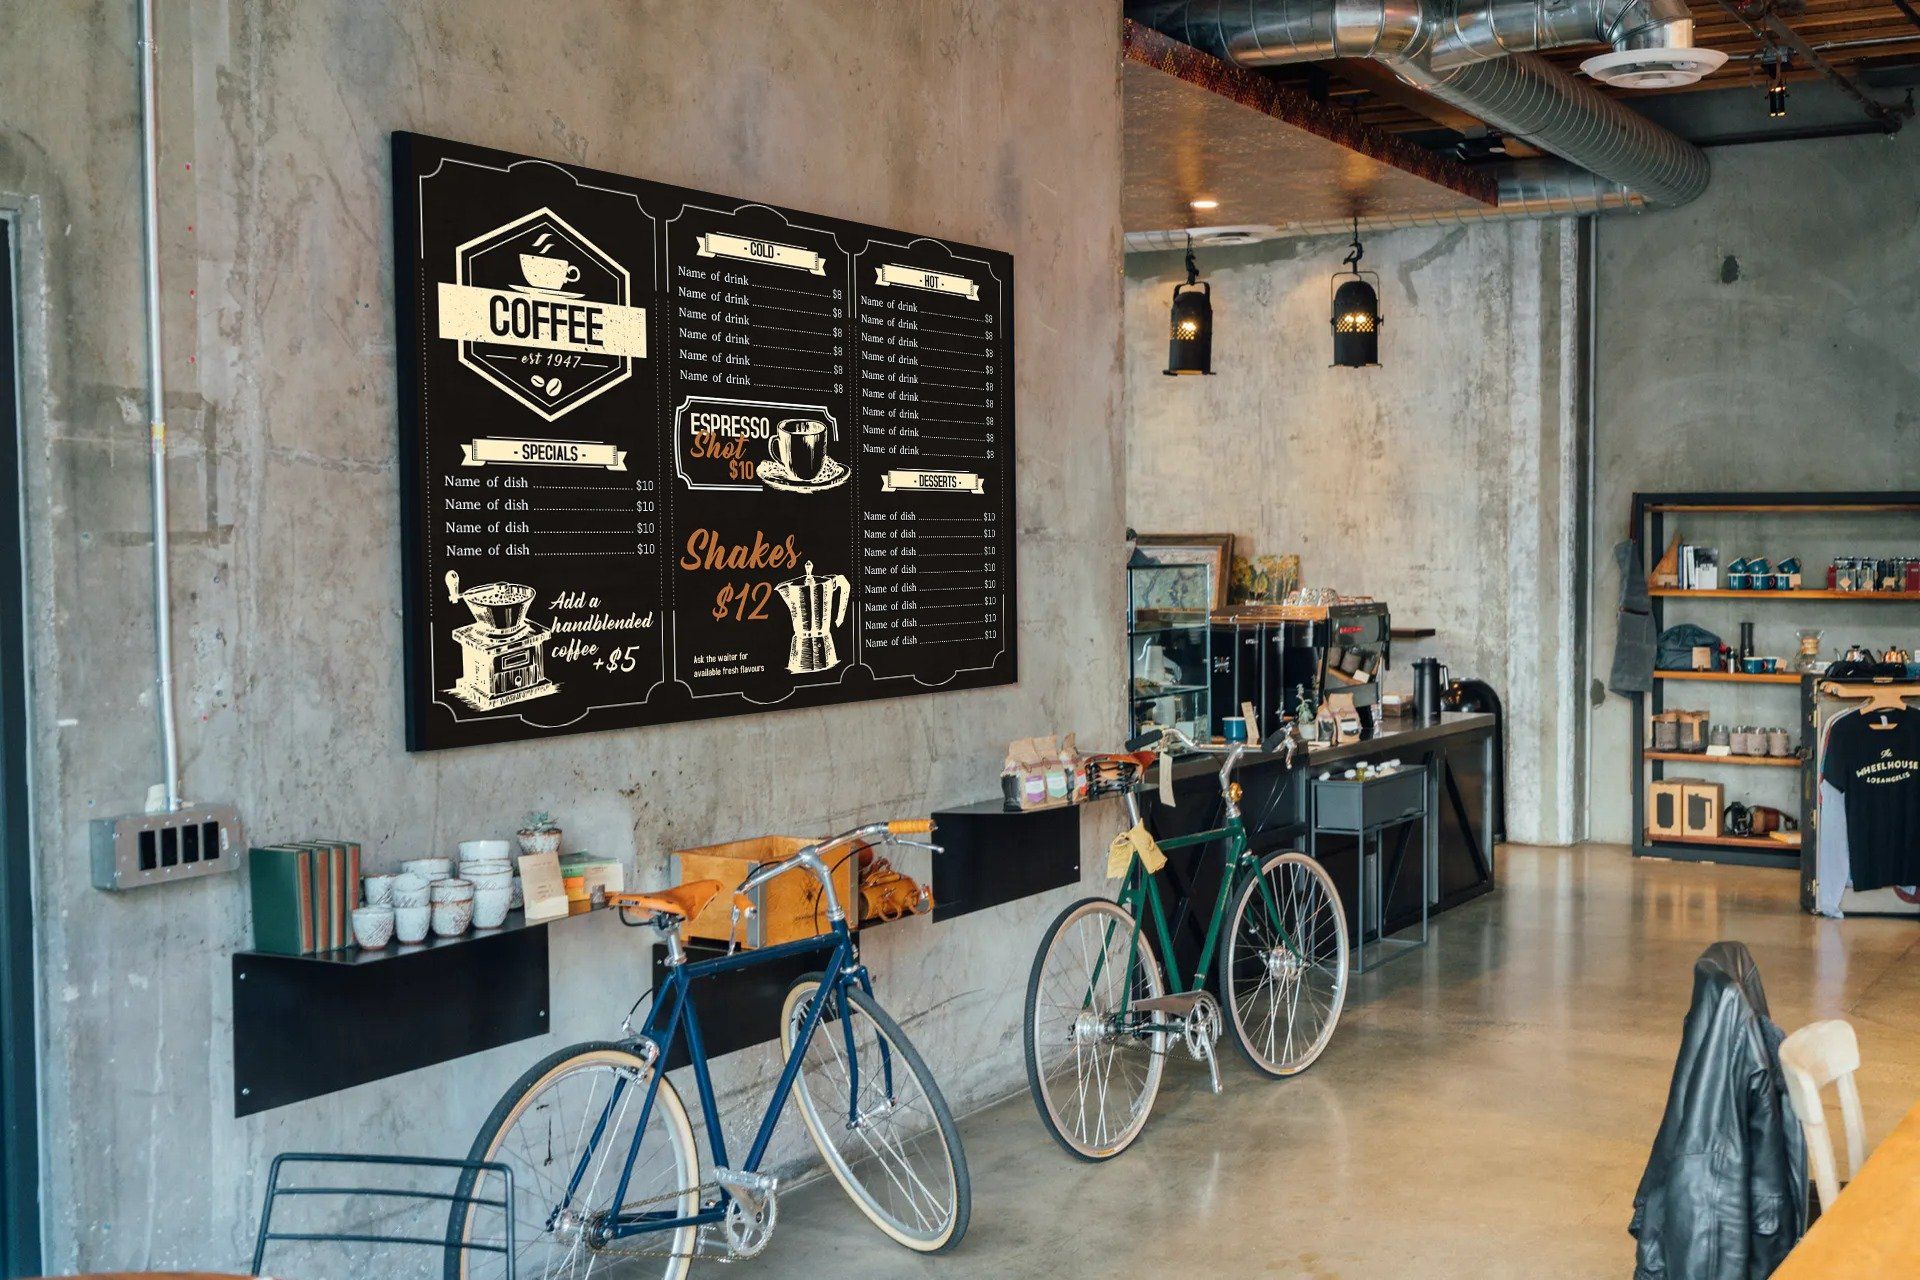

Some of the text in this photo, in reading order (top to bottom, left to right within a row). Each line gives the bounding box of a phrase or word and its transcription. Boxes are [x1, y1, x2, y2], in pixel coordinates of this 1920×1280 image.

[750, 242, 774, 259] COLD
[678, 265, 842, 299] Name of drink $8
[924, 275, 939, 289] HOT
[679, 286, 842, 318] Name of drink $8
[861, 295, 883, 307] Name
[887, 300, 895, 308] of
[898, 301, 917, 312] drink
[490, 295, 604, 346] COFFEE
[679, 307, 842, 338] Name of drink $8
[861, 314, 883, 325] Name
[887, 318, 895, 326] of
[898, 319, 918, 330] drink
[679, 328, 842, 356] Name of drink $8
[862, 332, 883, 343] Name
[887, 336, 895, 345] of
[898, 337, 918, 347] drink
[521, 352, 581, 369] est 1947
[679, 349, 843, 375] Name of drink $8
[862, 351, 884, 361] Name
[888, 354, 895, 362] of
[899, 355, 918, 365] drink
[680, 370, 843, 394] Name of drink $8
[862, 370, 884, 380] Name
[888, 373, 896, 381] of
[899, 373, 918, 383] drink
[862, 388, 884, 398] Name
[888, 391, 896, 399] of
[899, 391, 919, 401] drink
[863, 407, 884, 416] Name
[888, 409, 896, 417] of
[899, 409, 919, 419] drink
[690, 412, 769, 439] ESPRESSO
[863, 425, 885, 434] Name
[889, 426, 897, 435] of
[900, 427, 919, 436] drink
[522, 443, 578, 461] SPECIALS
[690, 430, 749, 459] Shot
[863, 444, 885, 453] Name
[889, 445, 897, 454] of
[900, 446, 919, 455] drink
[729, 458, 754, 480] $10
[445, 475, 653, 491] Name of dish $10
[919, 474, 957, 488] DESSERTS
[445, 499, 654, 513] Name of dish $10
[864, 512, 886, 520] Name
[890, 511, 897, 520] of
[901, 512, 916, 520] dish
[446, 521, 654, 533] Name of dish $10
[864, 530, 886, 538] Name
[890, 529, 898, 538] of
[901, 529, 916, 538] dish
[447, 543, 655, 556] Name of dish $10
[680, 528, 802, 571] Shakes
[865, 548, 886, 556] Name
[890, 547, 898, 556] of
[901, 547, 916, 555] dish
[865, 566, 887, 574] Name
[890, 565, 898, 574] of
[901, 565, 916, 573] dish
[865, 585, 887, 593] Name
[891, 583, 898, 592] of
[902, 583, 916, 592] dish
[548, 591, 601, 609] Add a
[712, 582, 773, 622] $12
[865, 603, 887, 611] Name
[891, 601, 898, 610] of
[902, 600, 917, 610] dish
[551, 611, 654, 633] handblended
[866, 621, 887, 630] Name
[891, 619, 899, 628] of
[902, 618, 917, 627] dish
[866, 639, 887, 647] Name
[891, 636, 899, 645] of
[902, 635, 917, 644] dish
[551, 638, 600, 662] coffee
[693, 652, 748, 664] Ask the waiter for
[693, 665, 765, 677] available fresh flavours
[1856, 760, 1919, 778] WHEELHOUSE
